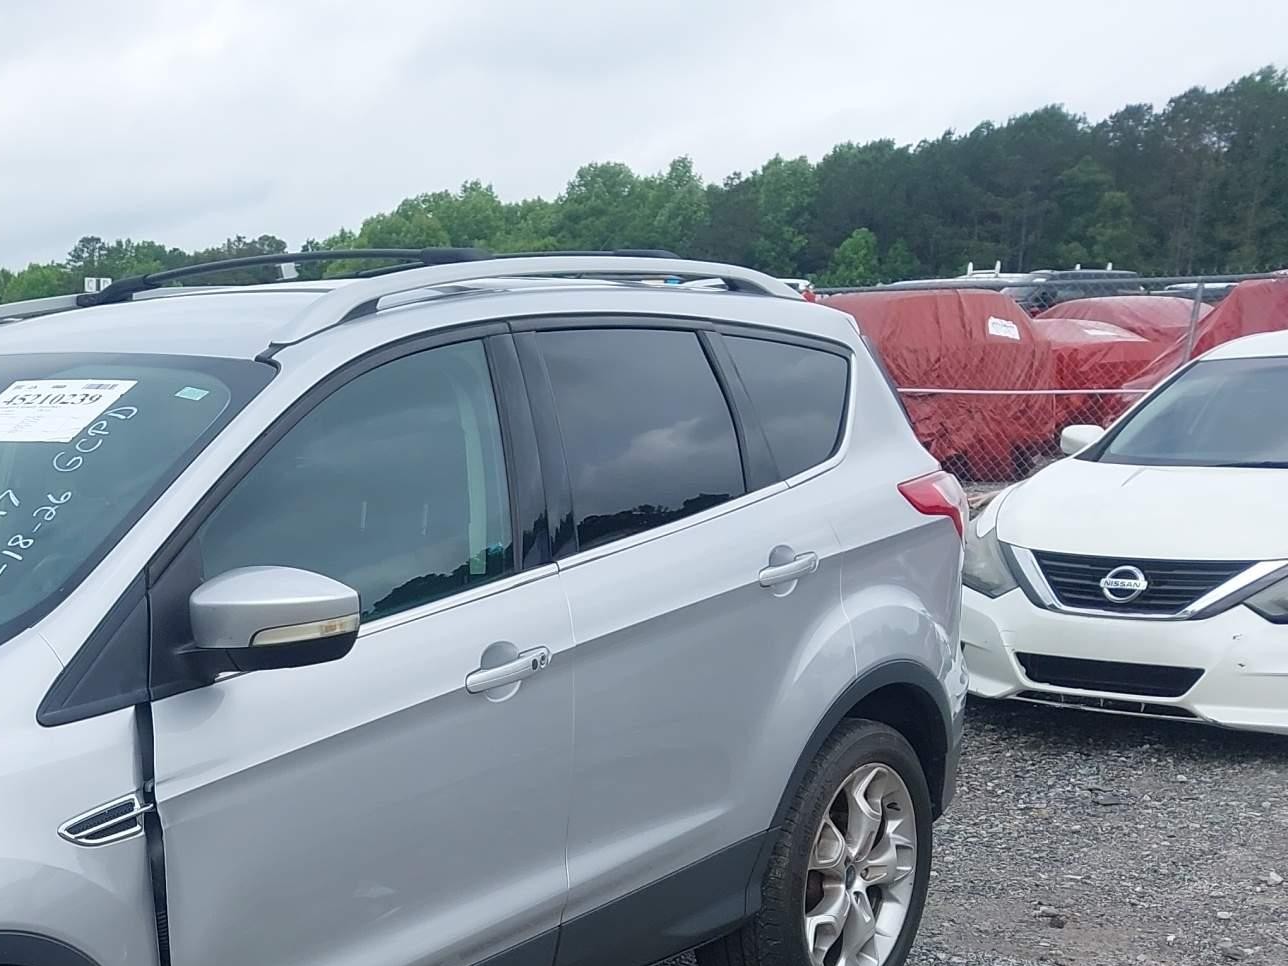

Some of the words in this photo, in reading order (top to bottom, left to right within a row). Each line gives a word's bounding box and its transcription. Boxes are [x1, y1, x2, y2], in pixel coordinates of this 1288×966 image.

[3, 393, 103, 406] 45210239
[52, 406, 138, 472] GCPD
[1103, 580, 1141, 588] NISSAN
